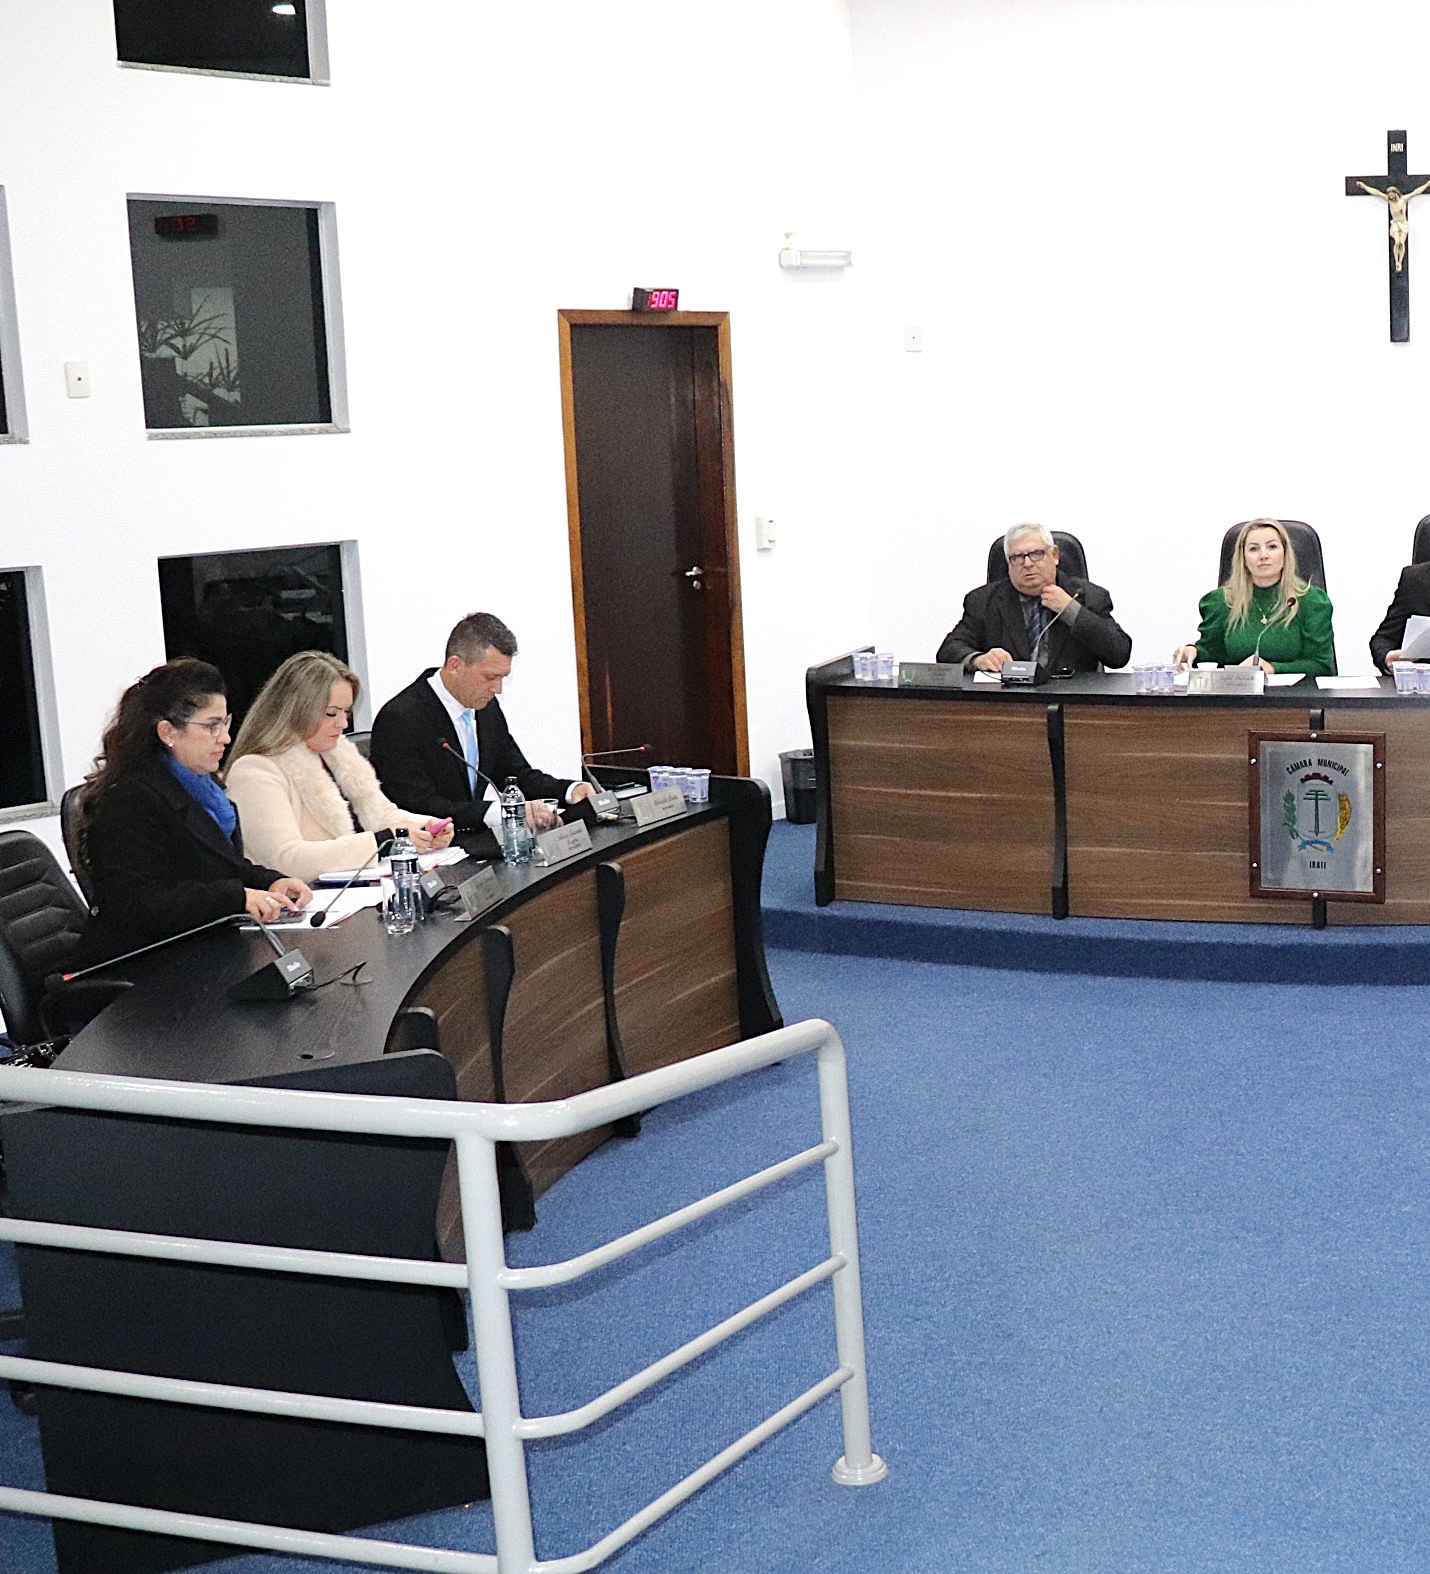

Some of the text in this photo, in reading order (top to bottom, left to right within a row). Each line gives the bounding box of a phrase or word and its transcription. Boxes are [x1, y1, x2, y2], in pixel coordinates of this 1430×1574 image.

[1391, 143, 1404, 152] INRI
[650, 290, 677, 309] 905
[1317, 758, 1350, 777] MUNICIPAL
[1309, 861, 1327, 869] IRATI
